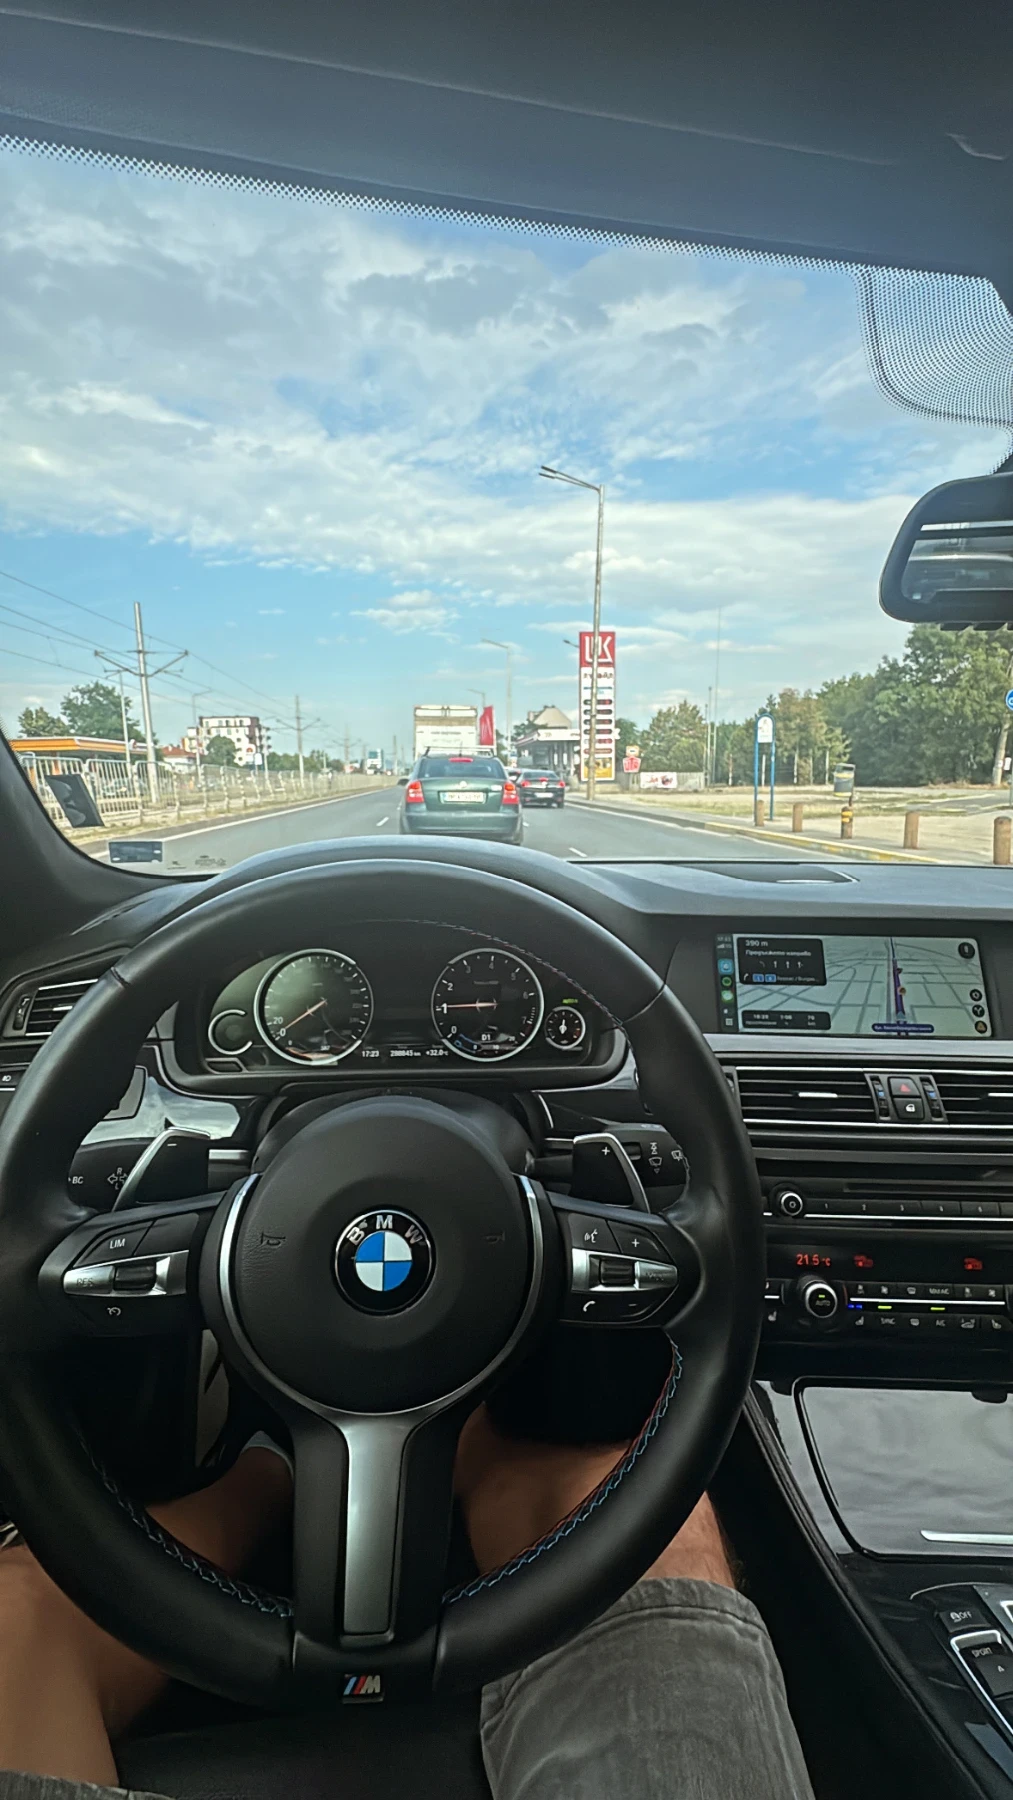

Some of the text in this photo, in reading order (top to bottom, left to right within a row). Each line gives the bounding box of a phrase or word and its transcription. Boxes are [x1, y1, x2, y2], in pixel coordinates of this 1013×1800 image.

[447, 982, 454, 991] 2
[441, 1002, 448, 1014] 1
[272, 1016, 284, 1025] 20
[280, 1028, 286, 1037] 0
[451, 1025, 458, 1034] 0
[361, 1050, 380, 1058] 17:23
[117, 1167, 123, 1175] R
[72, 1176, 84, 1185] BC
[346, 1214, 423, 1246] BMW
[109, 1238, 126, 1249] LIM
